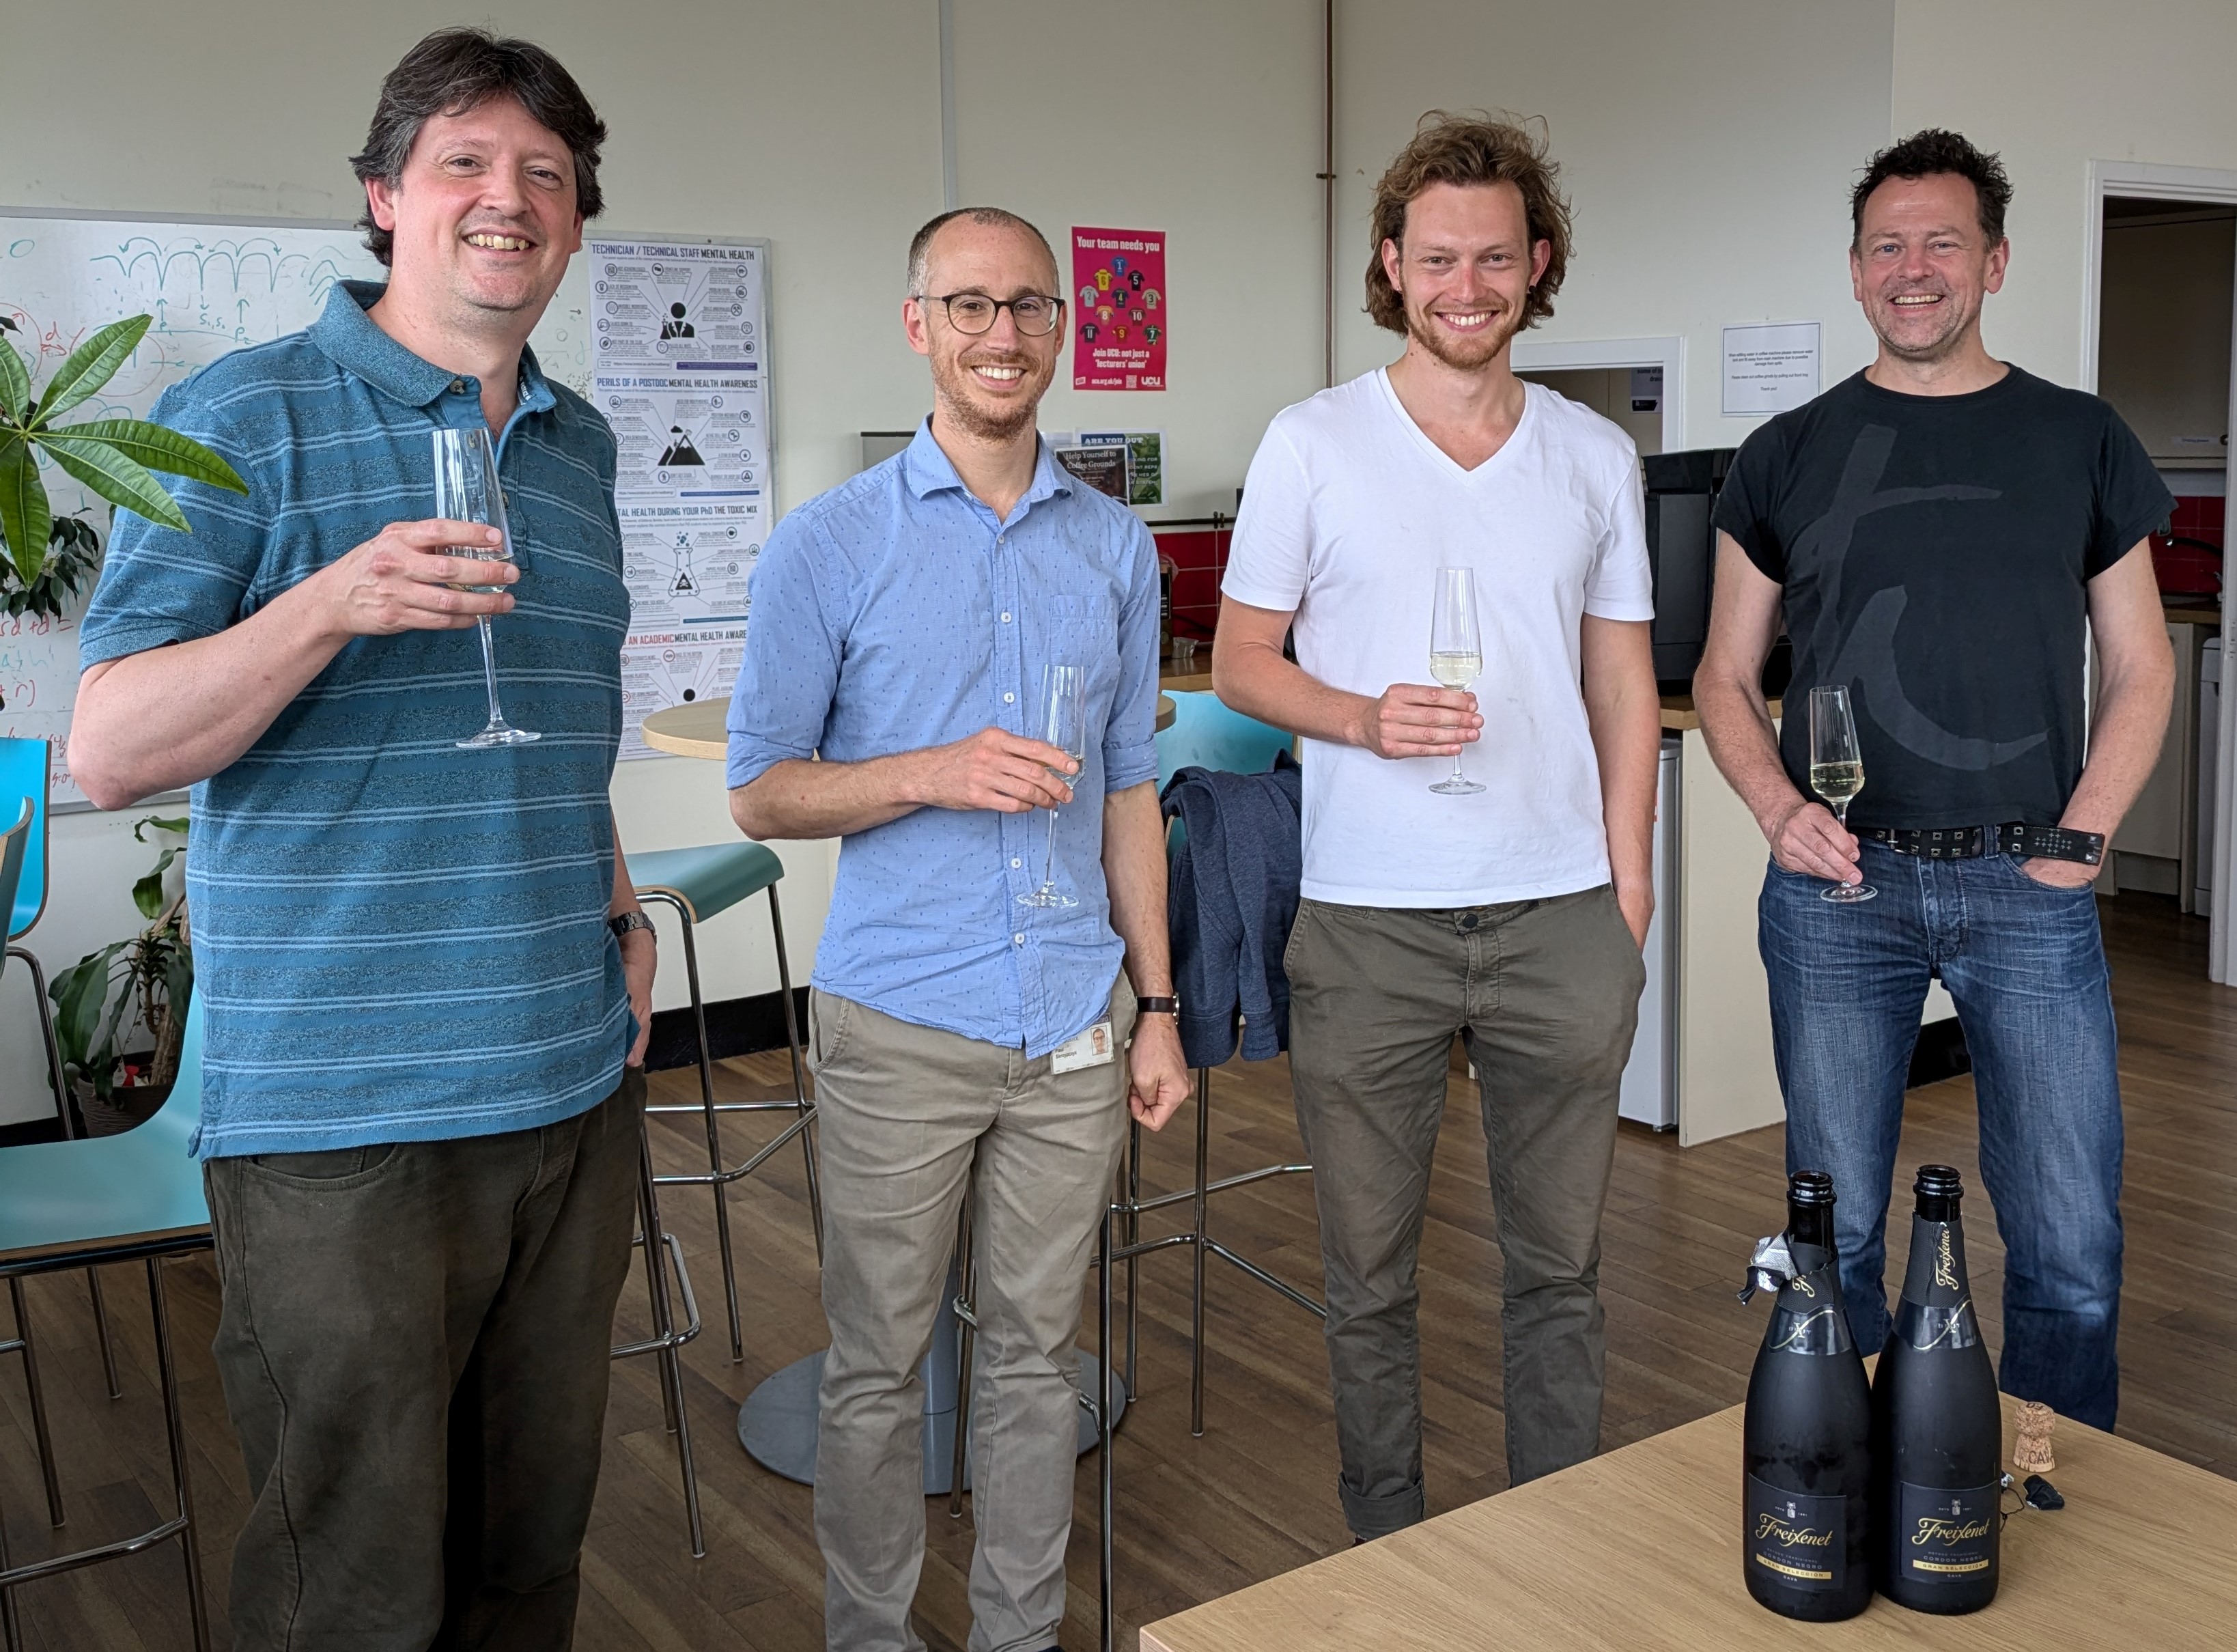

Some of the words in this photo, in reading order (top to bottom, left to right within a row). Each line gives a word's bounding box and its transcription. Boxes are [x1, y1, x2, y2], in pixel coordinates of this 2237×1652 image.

[1077, 236, 1095, 249] Your
[1097, 238, 1118, 249] team
[1120, 240, 1143, 251] needs
[1144, 242, 1160, 254] you
[592, 244, 634, 255] TECHNICIAN
[643, 247, 679, 257] TECHNICAL
[680, 248, 700, 258] STAFF
[701, 249, 727, 260] MENTAL
[729, 250, 755, 260] HEALTH
[1117, 261, 1122, 270] 1
[1101, 276, 1106, 286] 6
[1133, 275, 1138, 285] 5
[1086, 291, 1092, 300] 2
[1118, 293, 1123, 302] 4
[1148, 294, 1154, 303] 3
[1101, 311, 1107, 320] 8
[1132, 311, 1142, 321] 10
[1119, 329, 1124, 339] 9
[1150, 331, 1155, 339] 7
[1093, 348, 1106, 357] Join
[1107, 348, 1121, 357] UCU:
[1121, 349, 1132, 357] not
[1132, 349, 1144, 359] just
[597, 378, 621, 387] PERILS
[622, 378, 631, 387] OF
[632, 378, 637, 387] A
[639, 378, 669, 387] POSTDOC
[669, 378, 693, 388] MENTAL
[694, 379, 718, 388] HEALTH
[720, 380, 758, 389] AWARENESS
[1141, 376, 1160, 385] UCU
[1065, 451, 1081, 461] Help
[1082, 450, 1109, 458] Yourself
[1067, 461, 1087, 469] Coffee
[1088, 460, 1116, 468] Grounds
[617, 508, 630, 517] TAL
[632, 508, 656, 516] HEALTH
[657, 507, 681, 516] DURING
[681, 507, 699, 515] YOUR
[700, 506, 713, 515] PhD
[714, 505, 726, 514] THE
[727, 505, 745, 514] TOXIC
[746, 505, 758, 514] MIX
[628, 636, 638, 645] AN
[640, 634, 675, 644] ACADEMIC
[675, 632, 699, 642] MENTAL
[700, 631, 723, 641] HEALTH
[725, 630, 747, 640] AWARE
[2028, 1448, 2051, 1465] CAV
[1755, 1513, 1833, 1548] Freixenet
[1911, 1517, 1990, 1546] Freixenet
[1763, 1551, 1792, 1565] CORDON
[1763, 1559, 1780, 1569] GRAN
